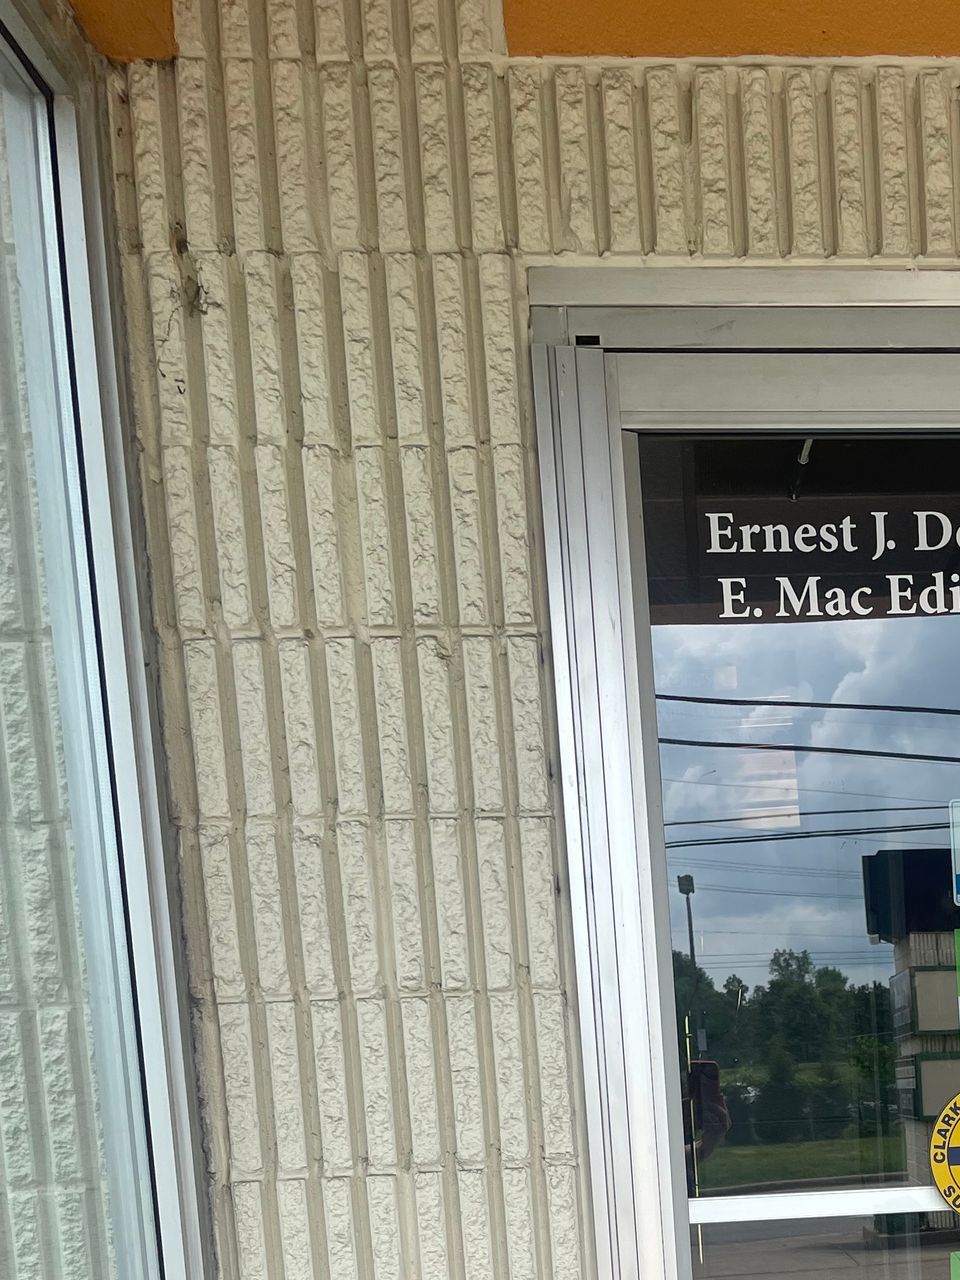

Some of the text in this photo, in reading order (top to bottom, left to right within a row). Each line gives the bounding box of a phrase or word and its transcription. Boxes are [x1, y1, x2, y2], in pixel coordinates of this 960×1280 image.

[705, 512, 857, 554] Ernest
[871, 511, 896, 560] J.
[717, 577, 762, 618] E.
[775, 576, 873, 617] Mac
